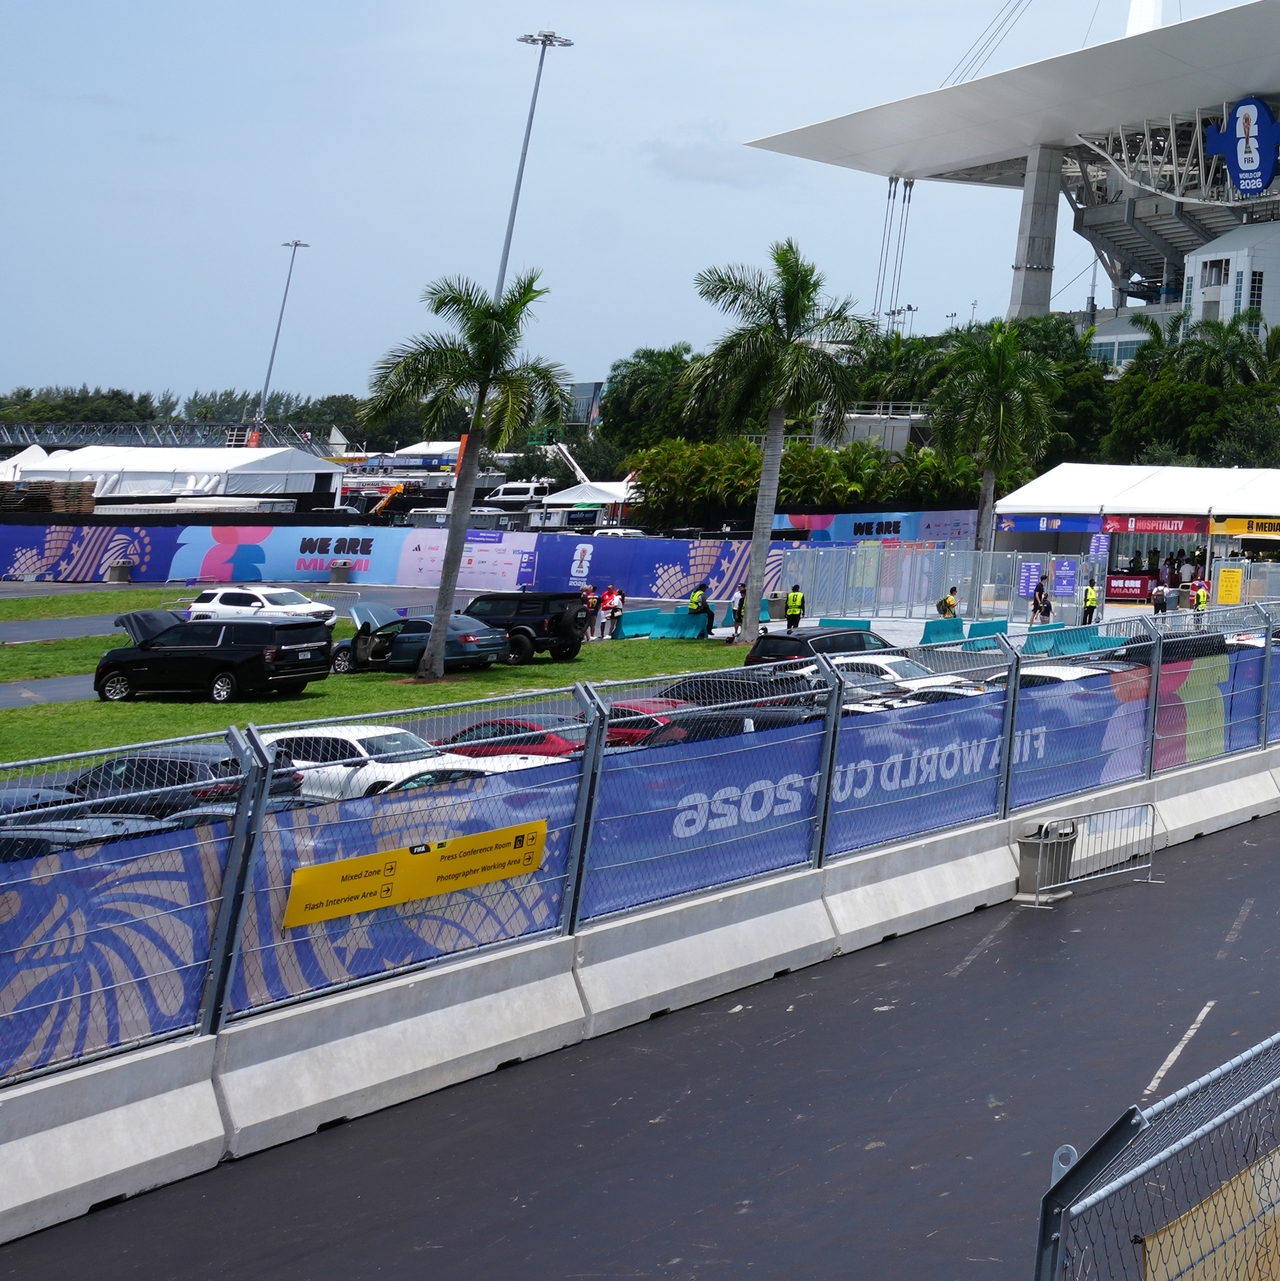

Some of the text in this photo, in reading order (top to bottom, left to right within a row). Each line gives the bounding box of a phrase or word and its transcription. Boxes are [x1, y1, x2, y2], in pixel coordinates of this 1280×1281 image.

[1240, 179, 1263, 189] 2026
[853, 521, 901, 536] WE ARE
[1048, 519, 1061, 529] VIP
[1136, 520, 1184, 531] HOSPITALITY
[1255, 522, 1280, 532] MEDIA
[299, 537, 374, 555] WE ARE
[1110, 579, 1124, 588] WE
[440, 841, 511, 862] Press Conference Room
[341, 868, 381, 882] Mixed Zone
[436, 858, 521, 883] Photographer Working Area
[304, 889, 378, 911] Flash Interview Area
